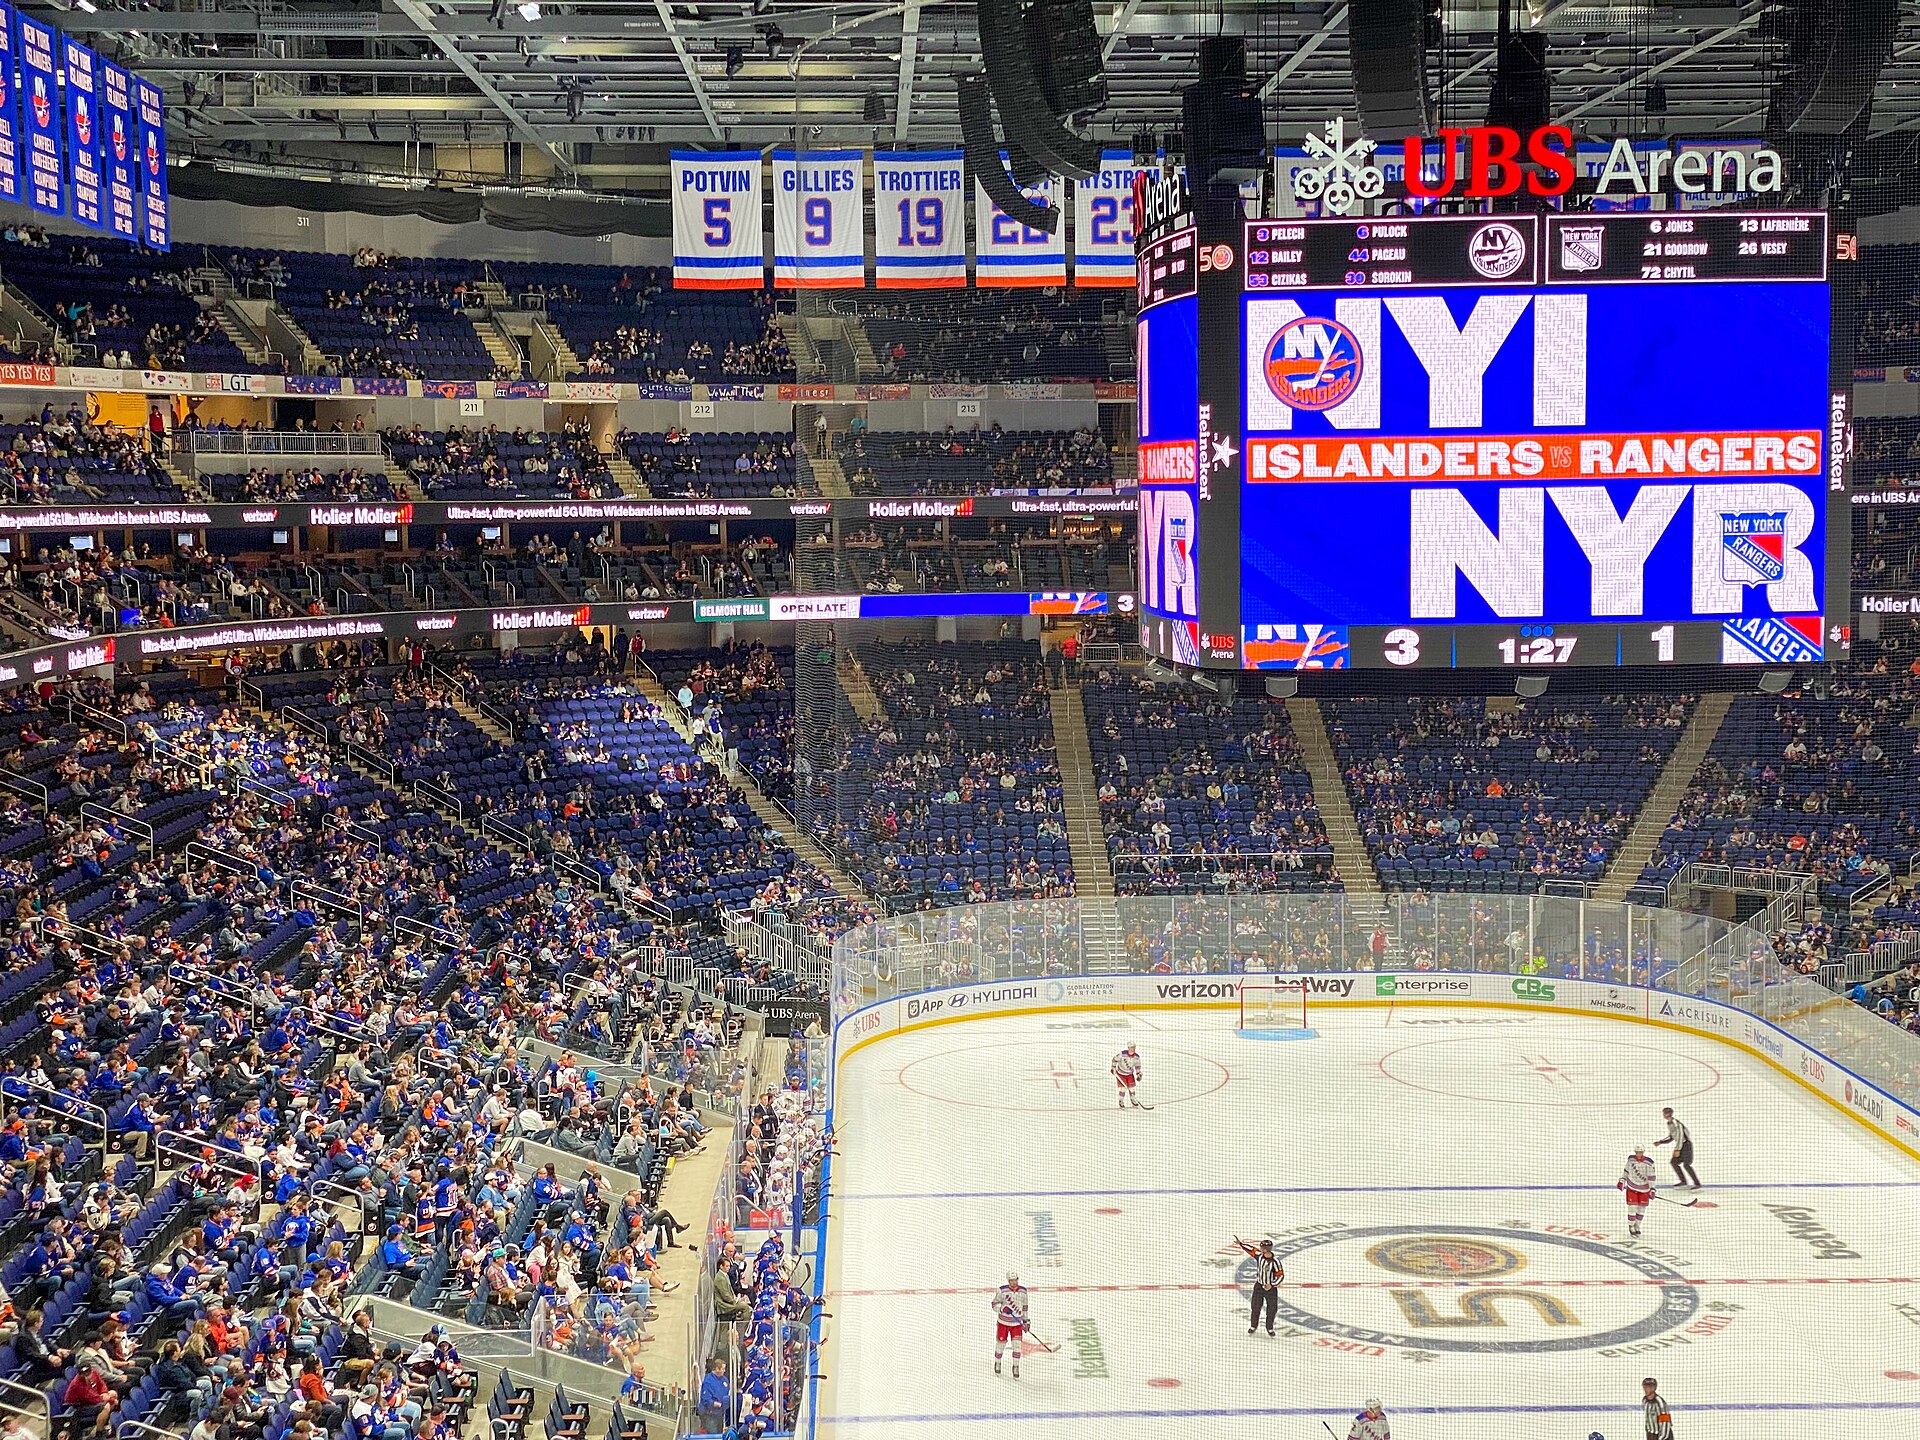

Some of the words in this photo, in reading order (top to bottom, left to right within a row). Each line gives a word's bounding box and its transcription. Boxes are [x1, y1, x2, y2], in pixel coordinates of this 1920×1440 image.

[1403, 126, 1576, 198] UBS
[1596, 138, 1782, 194] Arena
[682, 169, 751, 193] POTVIN
[782, 169, 855, 192] GILLIES
[878, 169, 961, 192] TROTTIER
[1145, 173, 1181, 229] Arena
[297, 217, 310, 227] 311
[703, 198, 732, 248] 5
[805, 198, 832, 247] 9
[898, 197, 944, 247] 19
[1649, 220, 1662, 233] 6
[1665, 219, 1694, 233] JONES
[1739, 219, 1759, 233] 13
[1256, 228, 1269, 242] 3
[1271, 227, 1305, 241] PELECH
[1356, 225, 1369, 239] 6
[1372, 225, 1408, 238] PULOCK
[1565, 231, 1580, 241] NEW
[1581, 231, 1599, 241] YORK
[1348, 248, 1369, 262] 44
[1371, 248, 1406, 261] PAGEAU
[1643, 243, 1662, 257] 21
[1664, 242, 1709, 256] GOODROW
[1738, 242, 1758, 255] 26
[1761, 241, 1788, 255] VESEY
[1249, 251, 1269, 265] 12
[1271, 250, 1303, 263] BAILEY
[1475, 254, 1518, 273] ISLANDERS
[1249, 274, 1269, 287] 53
[1271, 273, 1308, 286] CIZIKAS
[1371, 271, 1412, 284] SOROKIN
[1641, 266, 1662, 279] 72
[1663, 265, 1696, 279] CHYTIL
[1247, 293, 1587, 430] NYI
[16, 365, 32, 380] YES
[34, 366, 51, 382] YES
[220, 374, 252, 392] LGI
[1273, 370, 1351, 405] ISLANDERS
[464, 403, 478, 412] 211
[694, 405, 710, 414] 212
[961, 405, 976, 413] 213
[1831, 393, 1846, 492] Heineken
[1199, 404, 1212, 501] Heineken
[1252, 441, 1545, 479] ISLANDERS
[1579, 437, 1817, 476] RANGERS
[1147, 444, 1195, 483] RANGERS
[1871, 492, 1882, 503] in
[1882, 491, 1906, 503] UBS
[492, 505, 563, 520] ultra-powerful
[563, 505, 578, 518] 5G
[579, 505, 603, 518] Ultra
[603, 504, 654, 518] Wideband
[654, 504, 662, 517] is
[662, 504, 684, 517] here
[686, 503, 696, 516] in
[696, 503, 717, 516] UBS
[789, 504, 827, 516] verizon
[868, 502, 912, 517] Holier
[1011, 501, 1062, 514] Ultra-fast,
[1062, 500, 1134, 513] ultra-powerful
[61, 512, 79, 526] Ultra
[79, 511, 119, 525] Wideband
[128, 511, 149, 525] here
[159, 510, 180, 524] UBS
[242, 510, 274, 523] verizon
[310, 508, 353, 525] Holier
[1724, 518, 1750, 533] NEW
[1753, 518, 1782, 532] YORK
[1410, 483, 1819, 619] NYR
[1732, 536, 1781, 577] RANGERS
[700, 604, 743, 618] BELMONT
[743, 603, 766, 616] HALL
[781, 604, 814, 613] OPEN
[816, 603, 847, 613] LATE
[1117, 595, 1134, 612] 3
[1862, 596, 1909, 613] Holier
[492, 613, 534, 630] Holier
[628, 607, 666, 621] verizon
[416, 617, 453, 631] verizon
[233, 632, 254, 644] Ultra
[254, 625, 300, 641] Wideband
[308, 624, 328, 637] here
[336, 622, 356, 635] UBS
[1210, 635, 1235, 649] UBS
[1383, 628, 1421, 666] 3
[1498, 637, 1578, 664] 1:27
[1651, 625, 1675, 661] 1
[1210, 649, 1235, 659] Arena
[1066, 983, 1115, 991] GLOBALIZATION
[1157, 979, 1235, 999] verizon
[1274, 975, 1355, 998] betway
[1382, 978, 1469, 992] enterprise
[972, 986, 1038, 1005] HYUNDAI
[771, 1008, 793, 1019] UBS
[861, 1011, 881, 1032] UBS
[1678, 1008, 1730, 1029] ACRISURE
[1753, 1028, 1784, 1058] Northwell
[1809, 1057, 1825, 1083] UBS
[1854, 1088, 1884, 1122] BACARDÍ
[1266, 1221, 1347, 1240] Arena
[1761, 1203, 1863, 1260] betway
[1544, 1224, 1610, 1241] UBS
[1610, 1240, 1693, 1267] Arena
[1685, 1314, 1733, 1336] UBS
[1312, 1336, 1387, 1357] UBS
[1597, 1333, 1693, 1359] Arena
